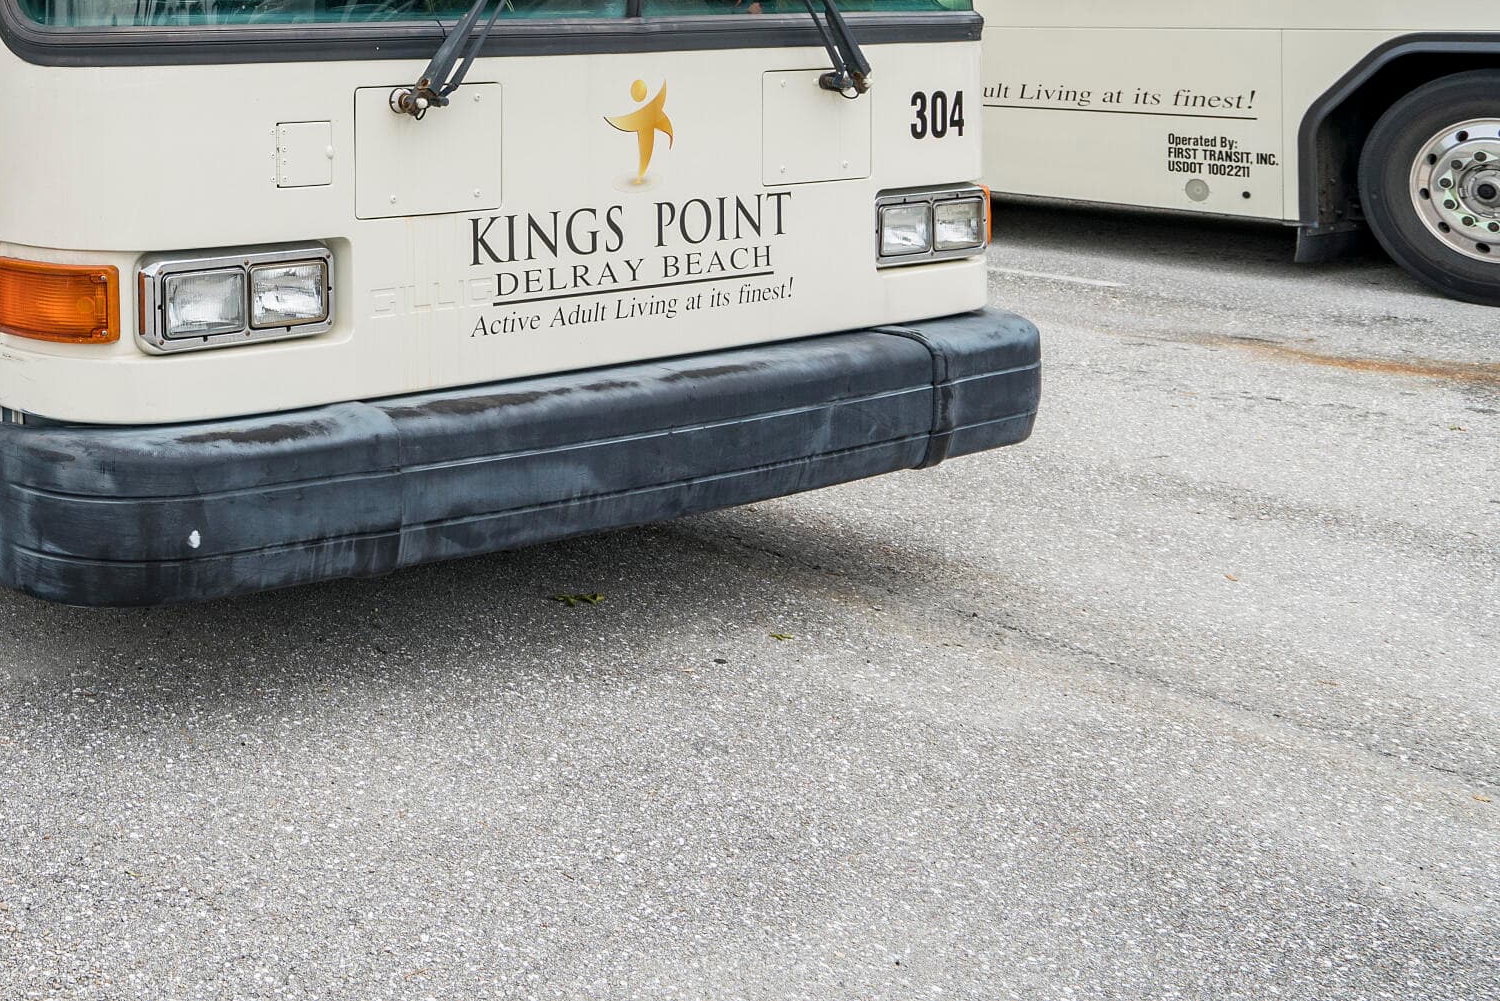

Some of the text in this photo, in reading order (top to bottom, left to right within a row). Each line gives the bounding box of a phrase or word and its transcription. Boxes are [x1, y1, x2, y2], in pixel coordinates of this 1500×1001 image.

[910, 90, 965, 140] 304
[983, 83, 1256, 111] ult Living at its finest!
[1168, 133, 1238, 150] Operated By:
[1168, 147, 1198, 160] FIRST
[1256, 153, 1279, 166] INC.
[1168, 160, 1250, 178] USDOT 1002211
[468, 191, 792, 267] KINGS POINT
[494, 245, 773, 297] DELRAY BEACH
[470, 277, 794, 339] Active Adult Living at its finest!
